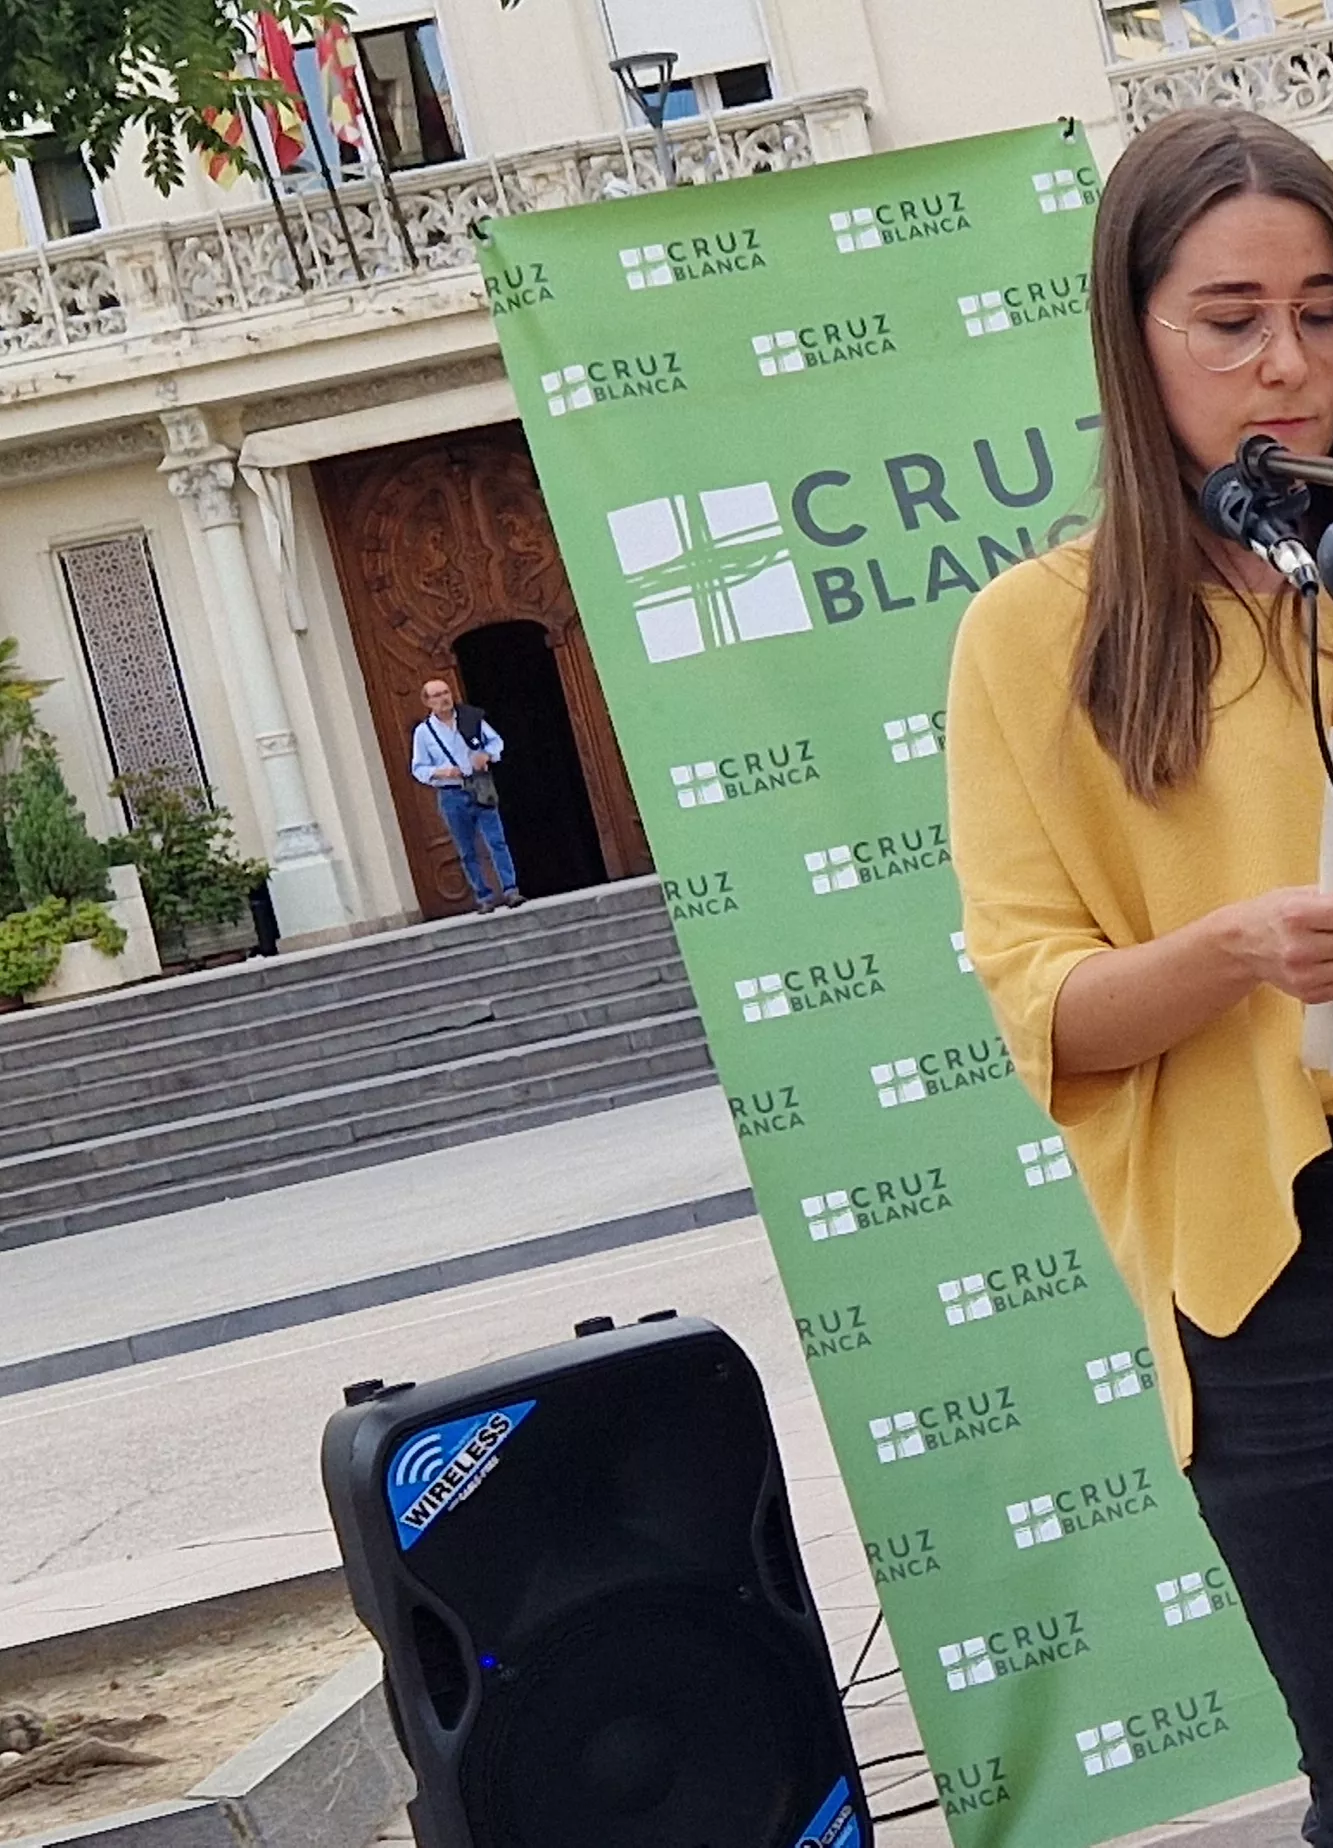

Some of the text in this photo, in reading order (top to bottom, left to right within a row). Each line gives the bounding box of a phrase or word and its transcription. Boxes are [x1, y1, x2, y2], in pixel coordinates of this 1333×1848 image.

[876, 192, 966, 226] CRUZ
[667, 228, 761, 263] CRUZ
[881, 214, 972, 245] BLANCA
[484, 263, 549, 298] RUZ
[673, 252, 767, 282] BLANCA
[491, 287, 555, 317] ANCA
[1010, 300, 1088, 327] BLANC
[799, 314, 891, 349] CRUZ
[588, 352, 682, 383] CRUZ
[804, 338, 897, 368] BLANCA
[593, 376, 688, 402] BLANCA
[813, 514, 1090, 625] BLAN
[719, 739, 815, 779] CRUZ
[724, 764, 821, 800] BLANCA
[853, 824, 948, 864] CRUZ
[859, 849, 951, 885] BLANCA
[664, 871, 734, 901] RUZ
[672, 896, 740, 922] ANCA
[784, 954, 880, 992] CRUZ
[790, 978, 886, 1014] BLANCA
[728, 1085, 800, 1119] RUZ
[738, 1111, 805, 1140] ANCA
[850, 1167, 948, 1210] CRUZ
[857, 1194, 953, 1230] BLANCA
[987, 1248, 1083, 1292] CRUZ
[993, 1274, 1089, 1314] BLANCA
[795, 1304, 867, 1341] RUZ
[804, 1331, 873, 1361] ANCA
[918, 1386, 1016, 1429] CRUZ
[925, 1412, 1022, 1452] BLANCA
[404, 1414, 511, 1528] WIRELESS
[1056, 1468, 1153, 1513] CRUZ
[1062, 1494, 1159, 1536] BLANCA
[865, 1528, 936, 1564] RUZ
[874, 1556, 941, 1586] ANCA
[988, 1611, 1086, 1656] CRUZ
[994, 1637, 1091, 1677] BLANCA
[1127, 1690, 1225, 1738] CRUZ
[1133, 1716, 1230, 1760] BLANCA
[935, 1756, 1007, 1796] RUZ
[944, 1785, 1012, 1818] ANCA
